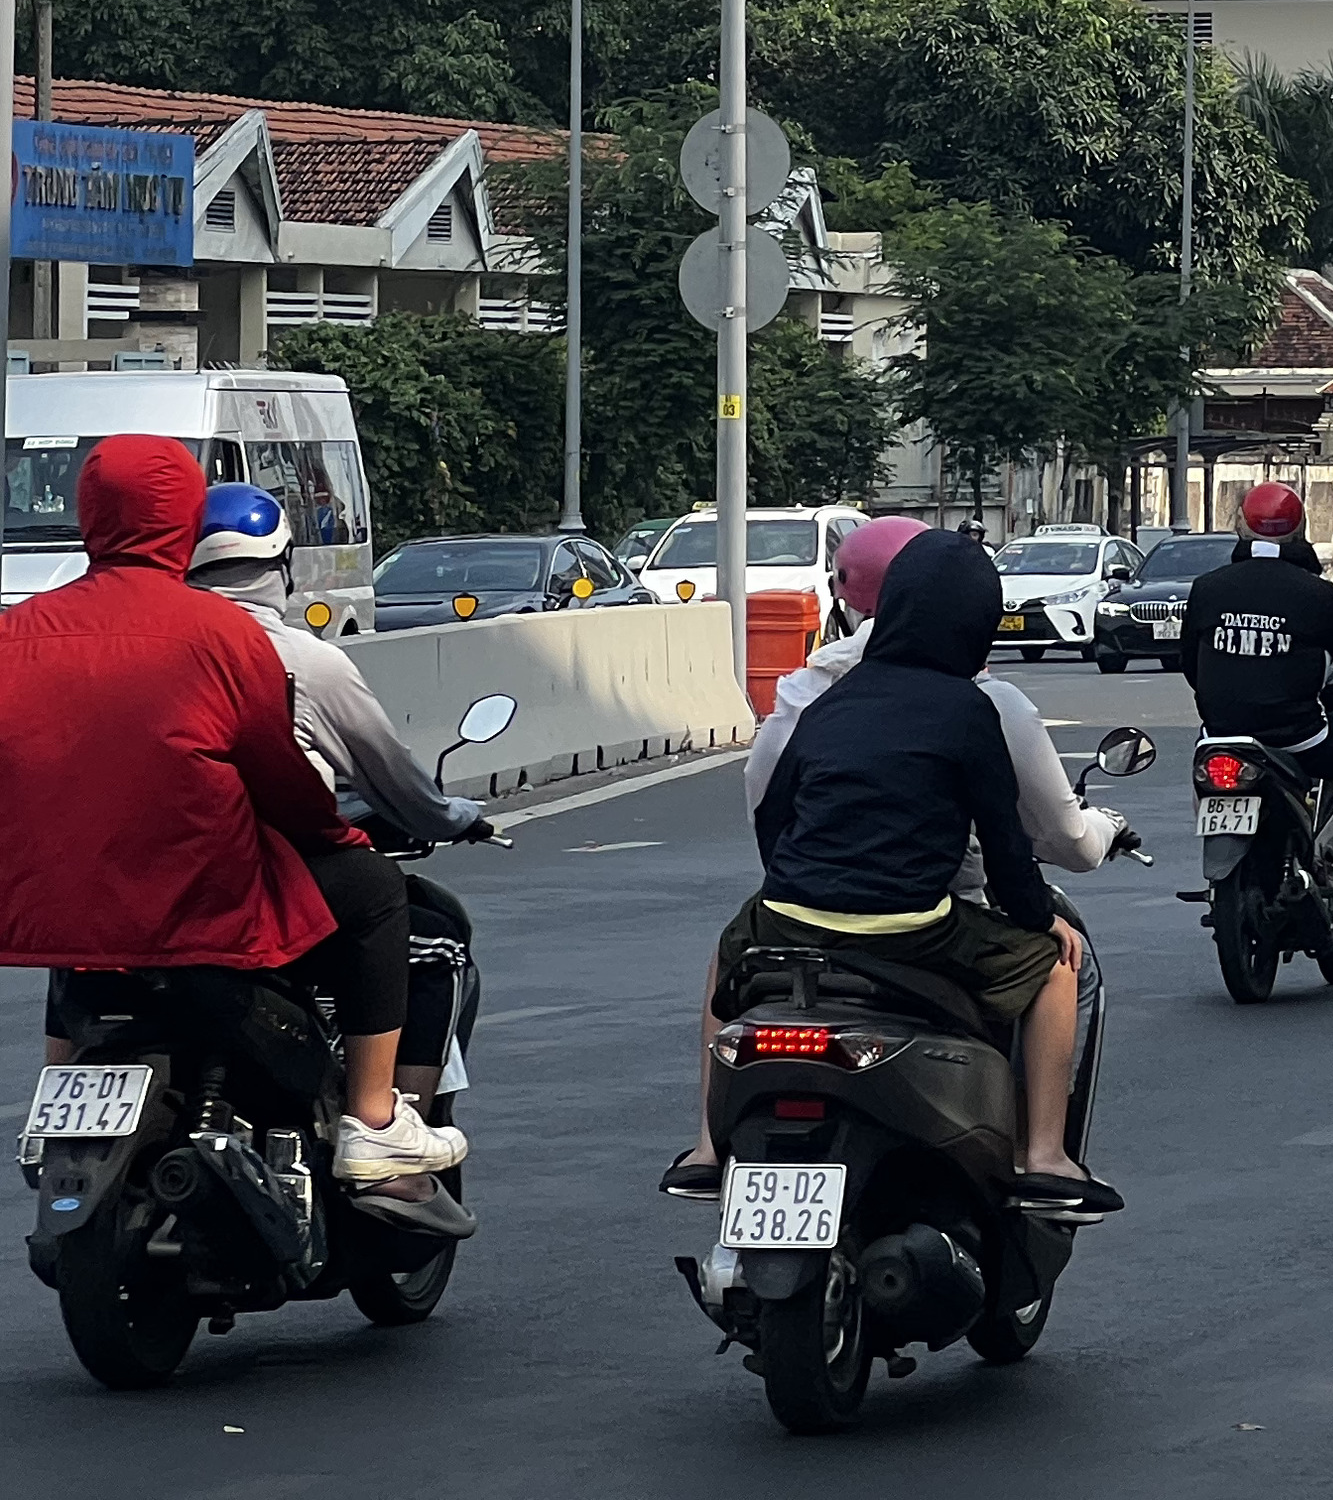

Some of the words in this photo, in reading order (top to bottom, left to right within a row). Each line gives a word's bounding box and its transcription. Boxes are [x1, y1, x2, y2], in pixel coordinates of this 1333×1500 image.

[723, 404, 735, 416] 03
[1207, 798, 1250, 814] 86-C1
[1201, 815, 1253, 833] 164.71
[53, 1072, 129, 1100] 76-D1
[35, 1102, 134, 1131] 531.47
[745, 1171, 827, 1204] 59-D2
[729, 1207, 833, 1242] 438.26
